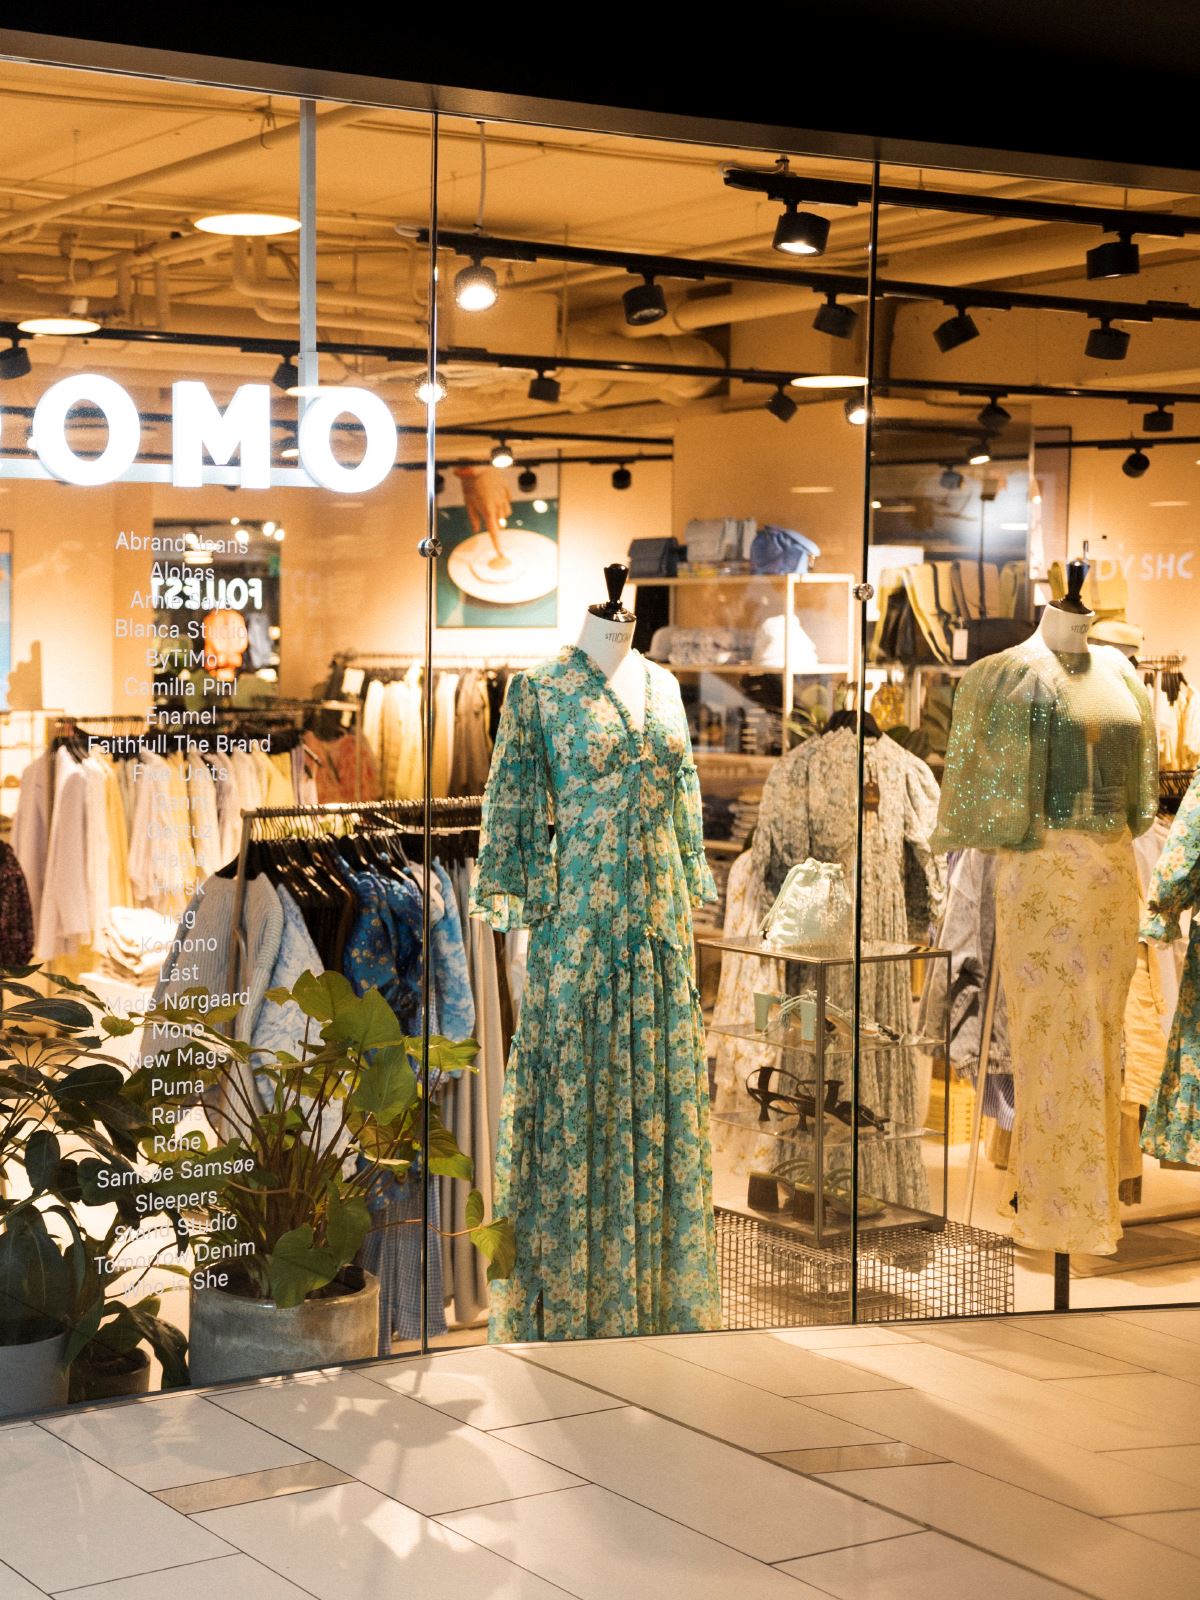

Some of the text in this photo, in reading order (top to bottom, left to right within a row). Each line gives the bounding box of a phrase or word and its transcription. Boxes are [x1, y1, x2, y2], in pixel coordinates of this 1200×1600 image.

[115, 530, 186, 552] Abrand
[150, 561, 215, 582] Alohas
[115, 618, 180, 638] Blanca
[146, 648, 218, 670] ByTiMo
[124, 677, 238, 696] Camilla Pihl
[146, 706, 216, 725] Enamel
[87, 733, 271, 754] Faithfull The Brand
[179, 763, 228, 782] Units
[141, 936, 217, 955] Komono
[160, 963, 199, 982] Läst
[105, 986, 250, 1014] Mads Nørgaard
[152, 1022, 204, 1040] Mono
[129, 1047, 227, 1069] New Mags
[151, 1078, 204, 1097] Puma
[152, 1105, 202, 1125] Rains
[154, 1133, 201, 1154] Róhe
[97, 1157, 254, 1188] Samsøe Samsøe
[135, 1190, 218, 1213] Sleepers
[177, 1213, 238, 1235] Studio
[94, 1239, 256, 1275] Tomorrow Denim
[193, 1270, 228, 1290] She
